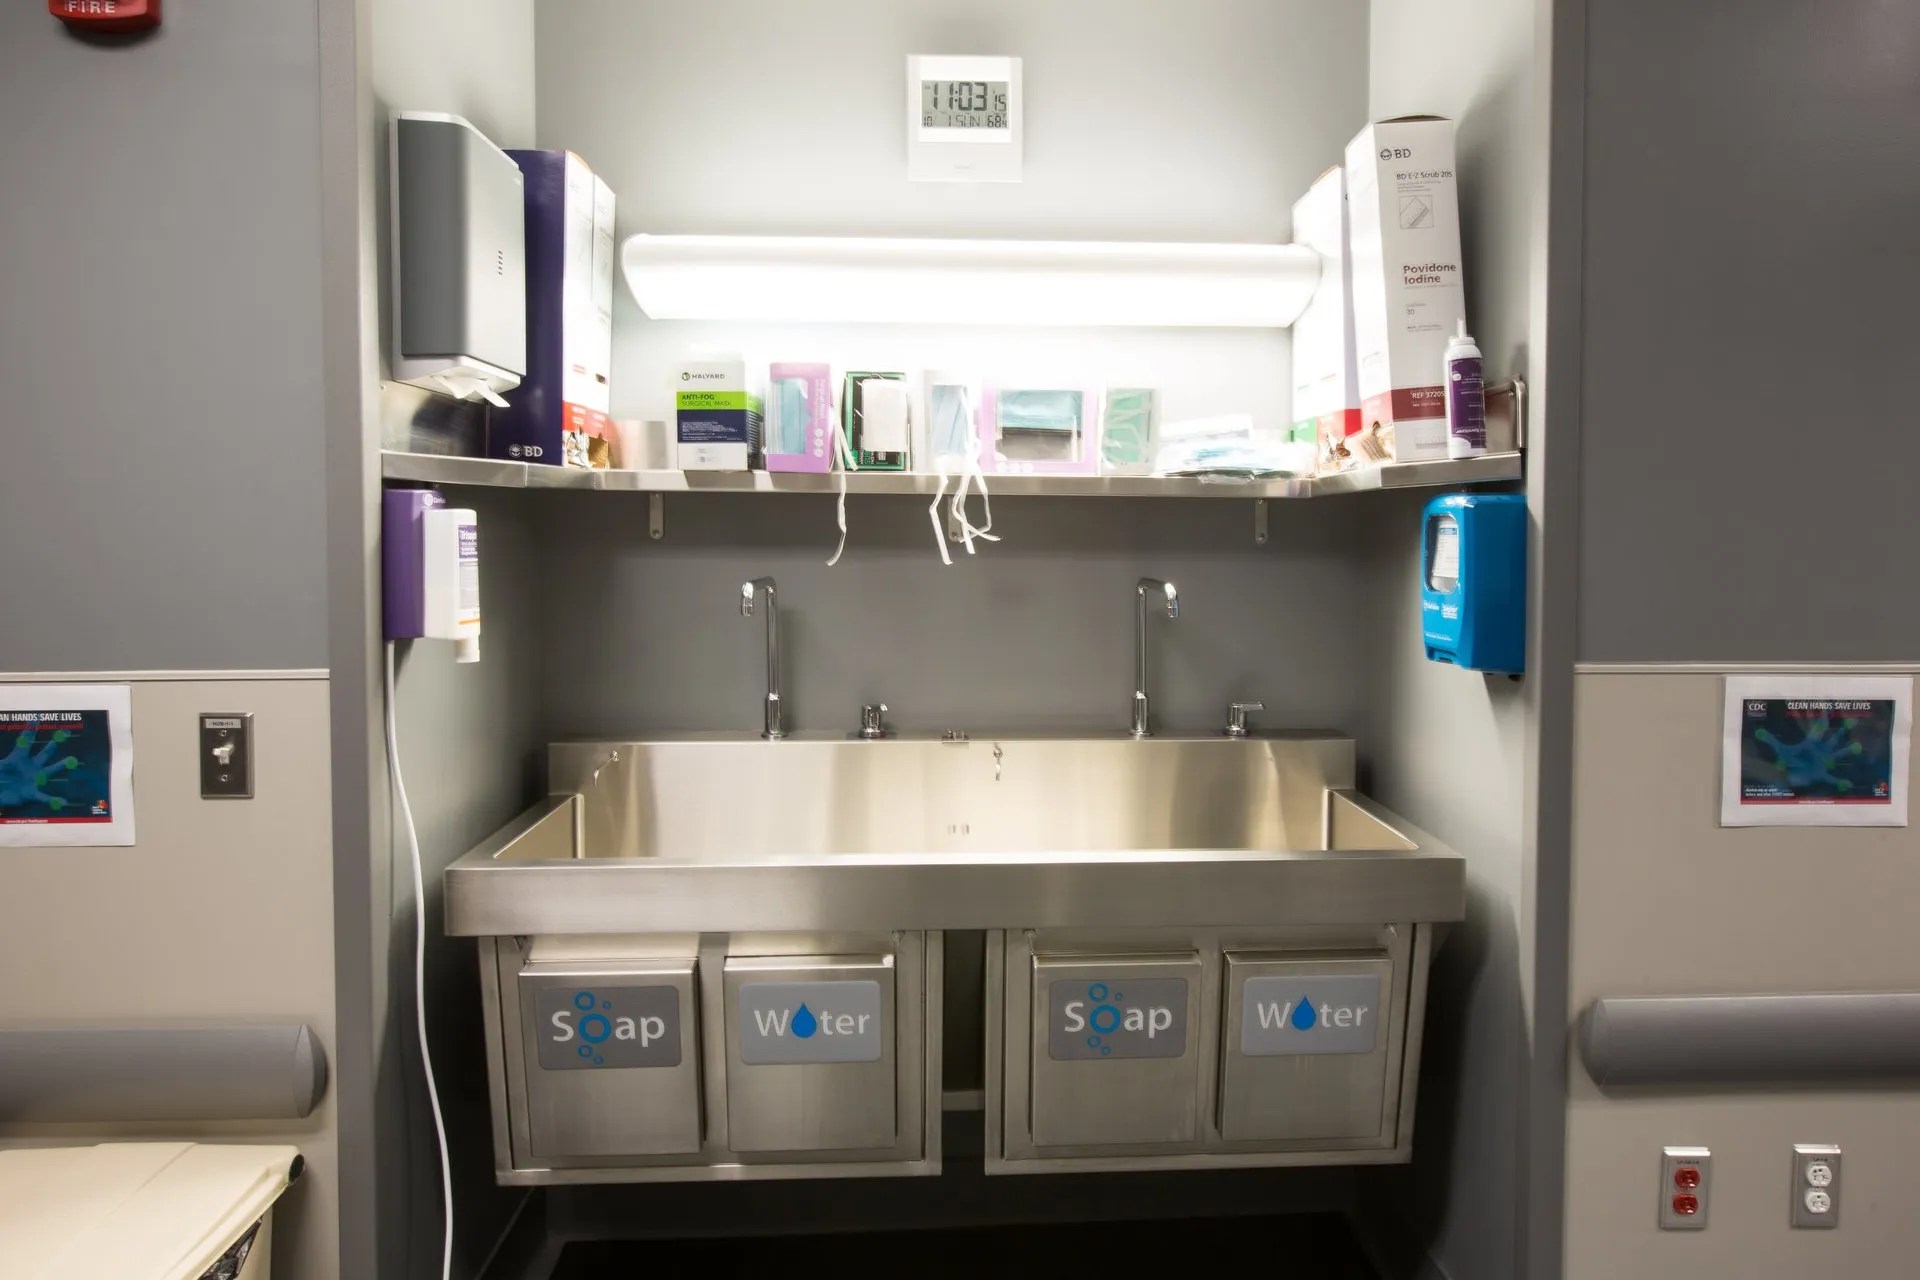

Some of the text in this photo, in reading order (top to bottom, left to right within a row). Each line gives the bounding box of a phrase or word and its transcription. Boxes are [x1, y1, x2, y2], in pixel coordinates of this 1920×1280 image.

[67, 1, 116, 13] FIRE
[933, 82, 987, 111] 11:03
[1394, 148, 1412, 159] BD
[1420, 171, 1439, 179] Scrub
[1403, 263, 1457, 274] Povidone
[1404, 274, 1441, 285] Iodine
[523, 446, 544, 457] BD
[1787, 702, 1871, 710] CLEAN HANDS SAVE LIVES
[11, 713, 38, 721] HANDS
[40, 712, 60, 721] SAVE
[61, 712, 82, 721] LIVES
[1257, 997, 1368, 1031] Wter
[754, 1004, 870, 1038] Wter
[1063, 1001, 1172, 1039] Soap
[551, 1010, 665, 1048] Soap
